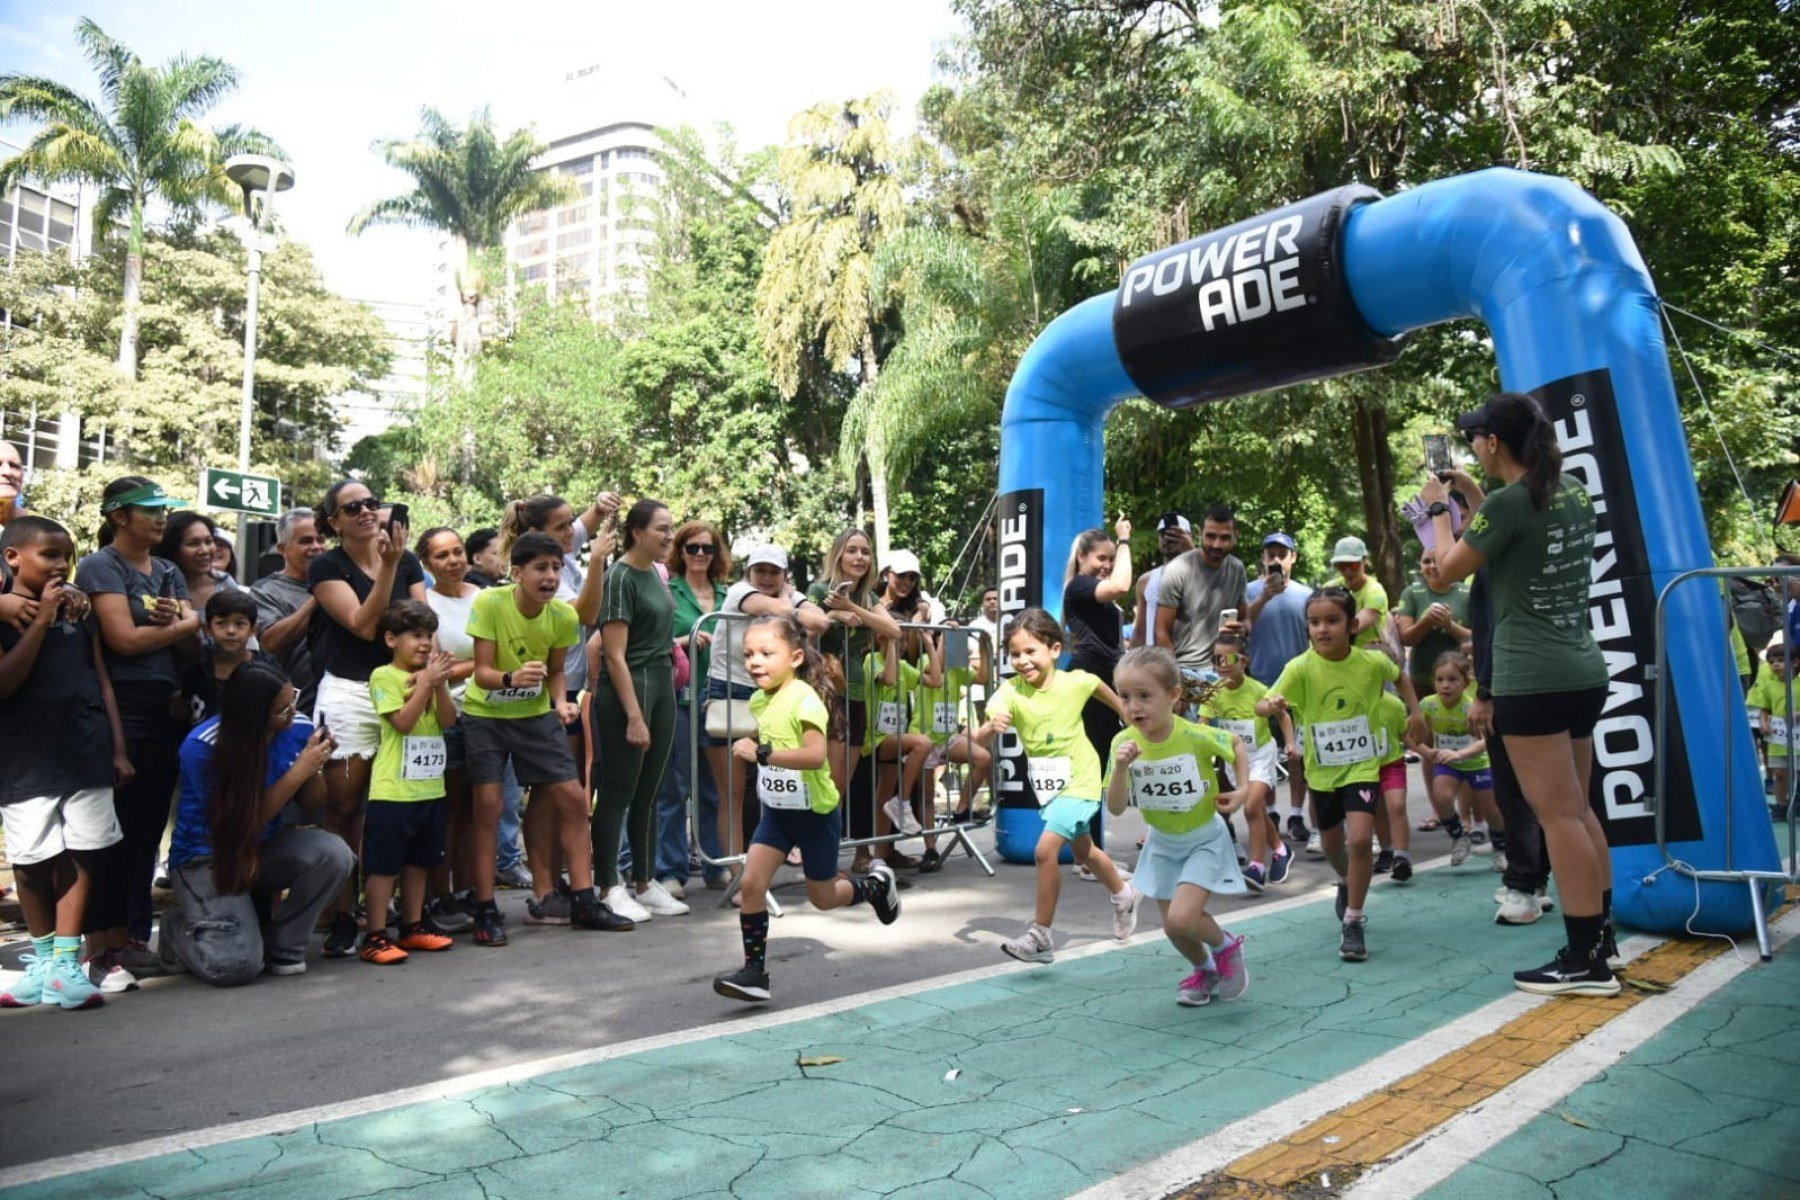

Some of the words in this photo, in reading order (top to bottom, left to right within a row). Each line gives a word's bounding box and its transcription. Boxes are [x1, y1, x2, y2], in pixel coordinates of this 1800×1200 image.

[1122, 215, 1303, 307] POWER
[1324, 735, 1368, 752] 4170
[413, 754, 444, 766] 4173
[1159, 764, 1182, 775] 420
[1141, 779, 1198, 797] 4261
